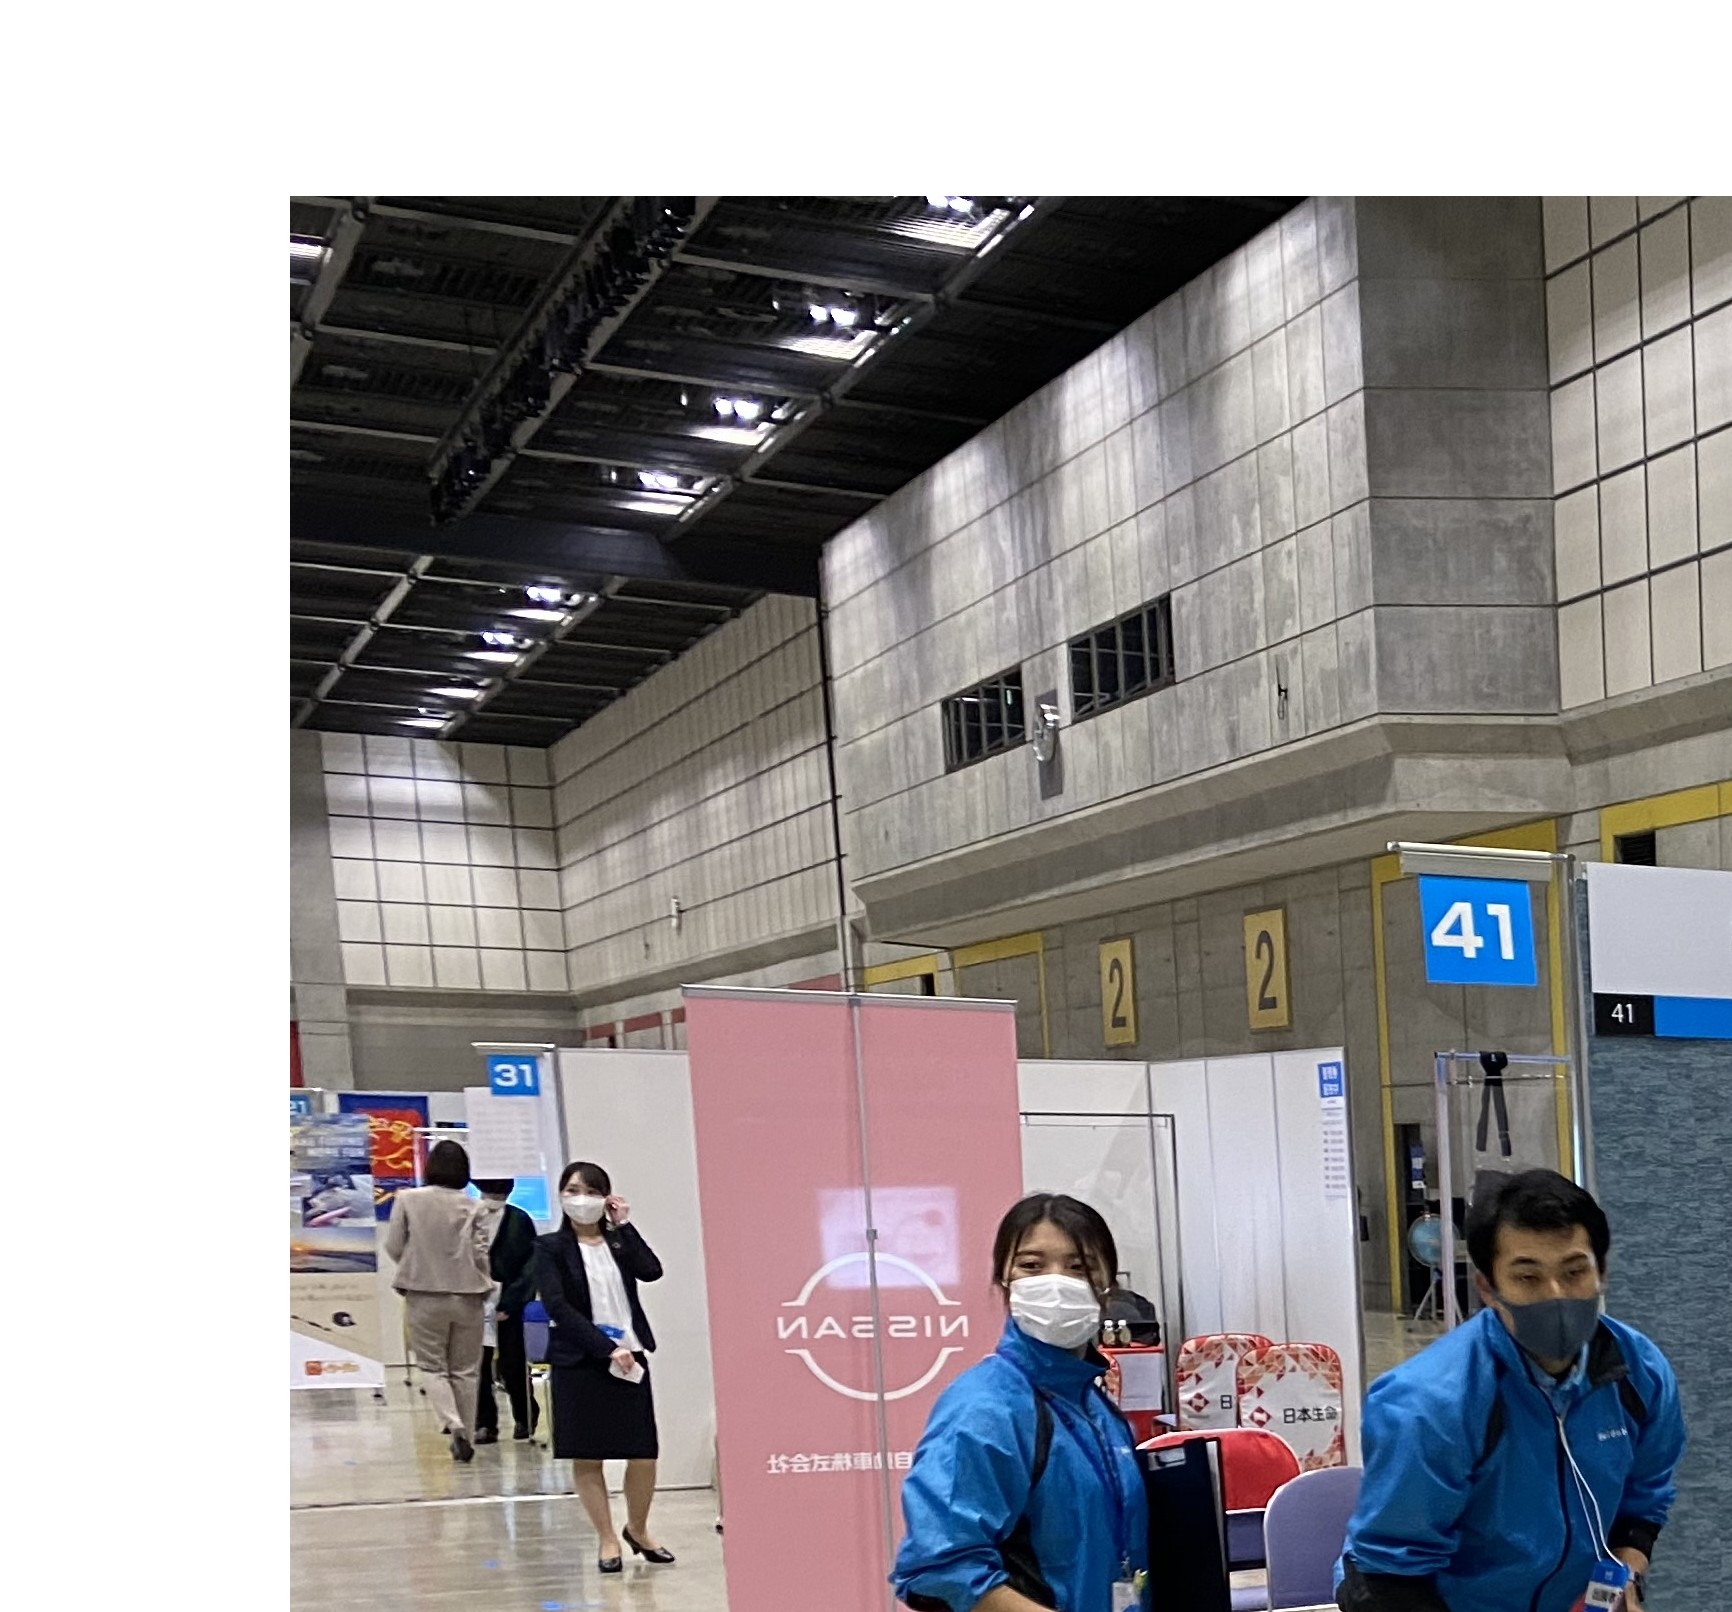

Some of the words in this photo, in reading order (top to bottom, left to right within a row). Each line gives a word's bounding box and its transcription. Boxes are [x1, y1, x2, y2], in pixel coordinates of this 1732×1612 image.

[1430, 901, 1515, 960] 41
[1254, 929, 1278, 1011] 2
[1108, 957, 1128, 1029] 2
[1610, 1003, 1634, 1024] 41
[493, 1063, 532, 1088] 31
[1283, 1405, 1338, 1424] 日本生命
